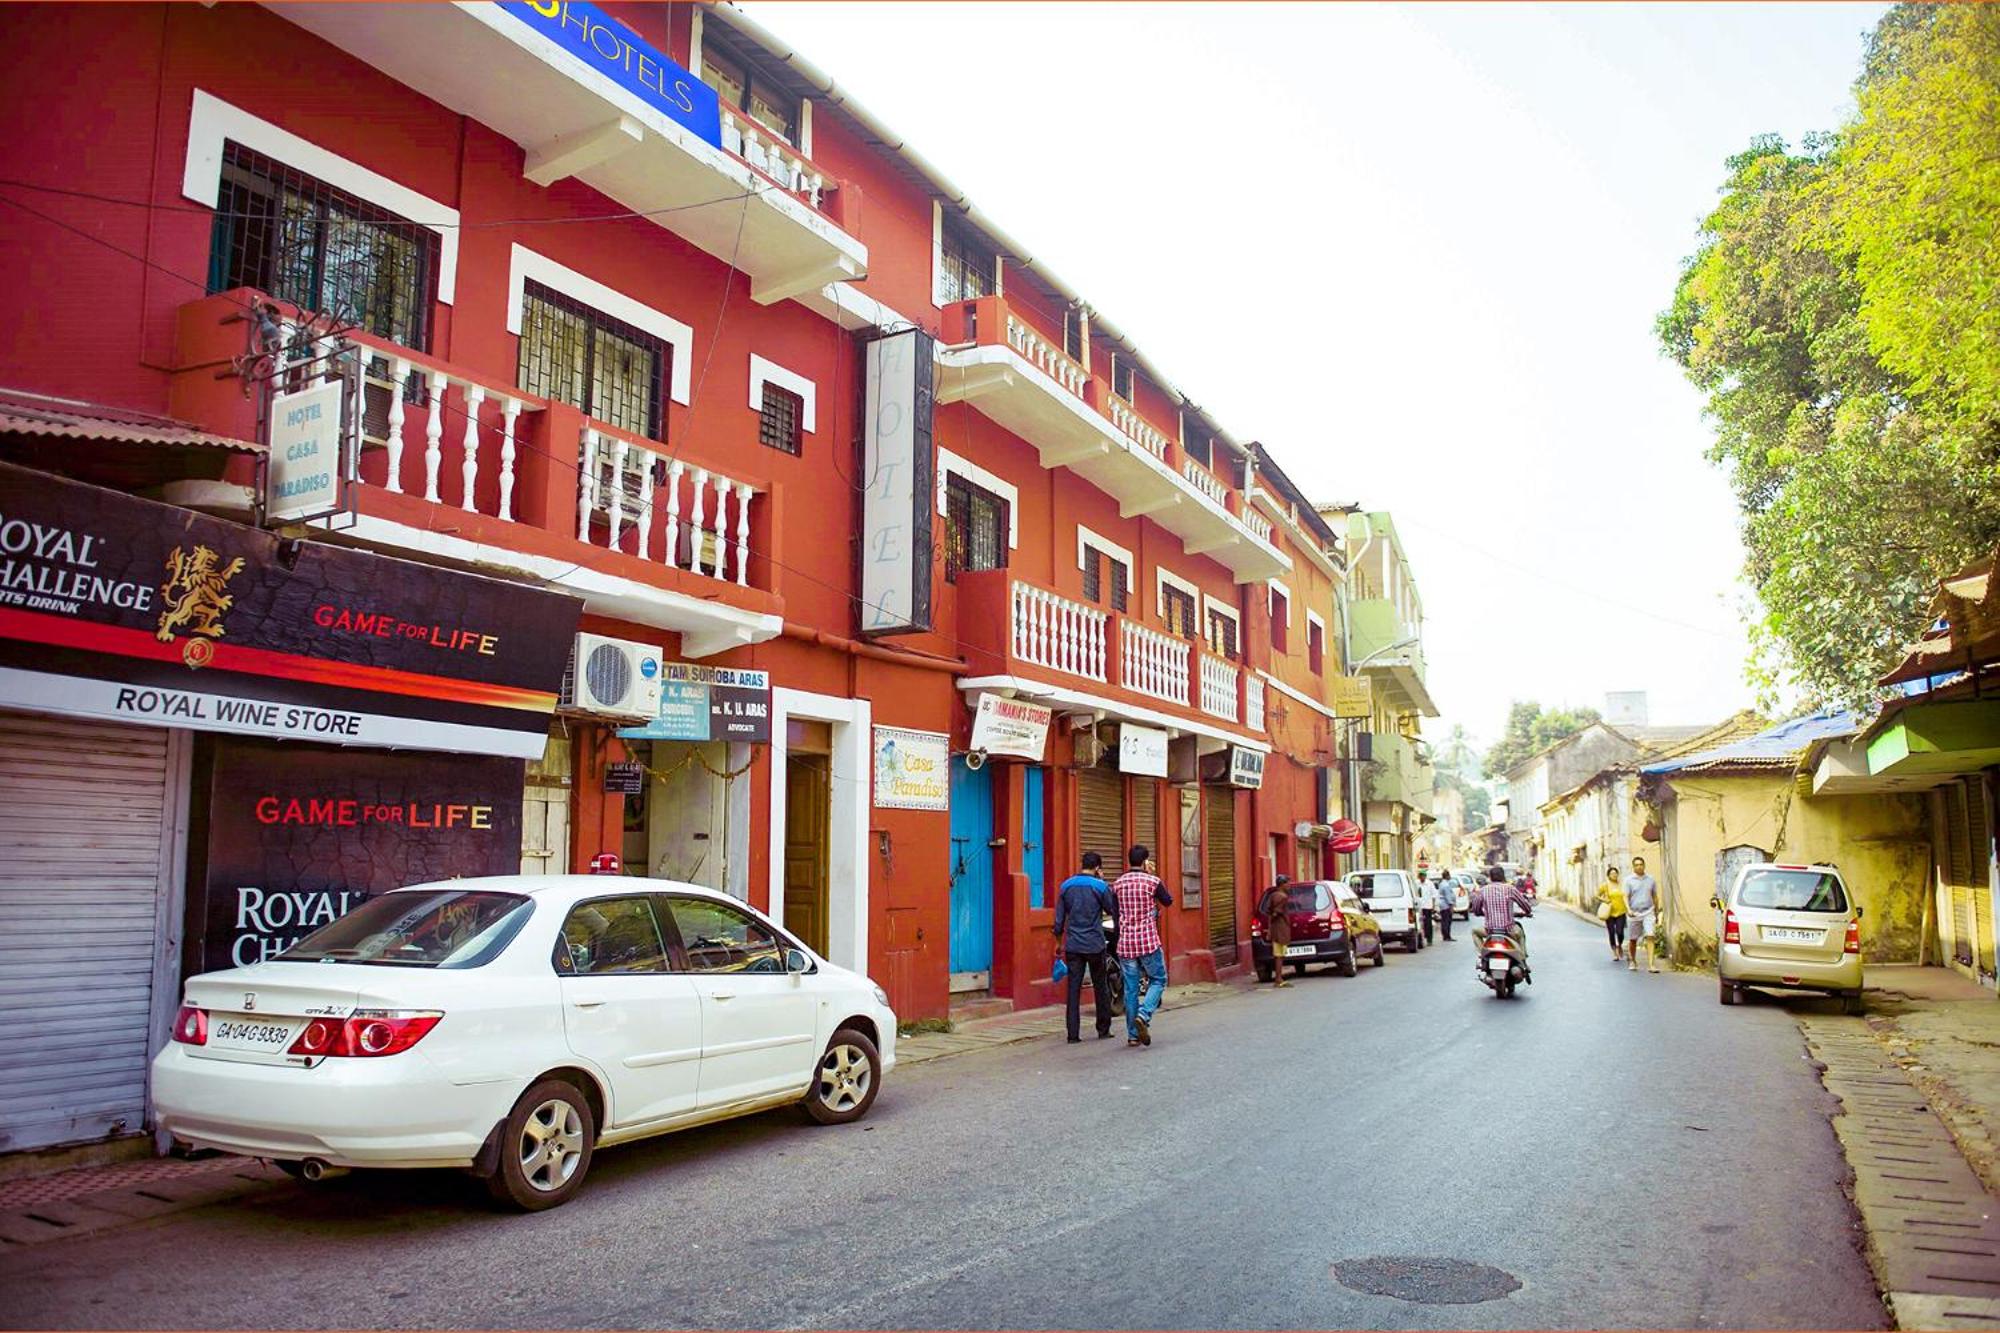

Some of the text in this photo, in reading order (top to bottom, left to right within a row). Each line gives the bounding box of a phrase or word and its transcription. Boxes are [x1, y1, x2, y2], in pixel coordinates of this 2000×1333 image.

[561, 2, 693, 113] HOTELS
[287, 403, 322, 427] HOTEL
[287, 440, 318, 460] CASA
[872, 340, 906, 628] HOTEL
[0, 512, 98, 568] OYAL
[27, 595, 80, 614] DRINK
[314, 604, 499, 656] GAME FOR LIFE
[739, 672, 764, 687] ARAS
[116, 688, 362, 736] ROYAL WINE STORE
[745, 703, 768, 717] ARAS
[904, 752, 934, 772] Casa
[255, 796, 493, 829] GAME FOR LIFE
